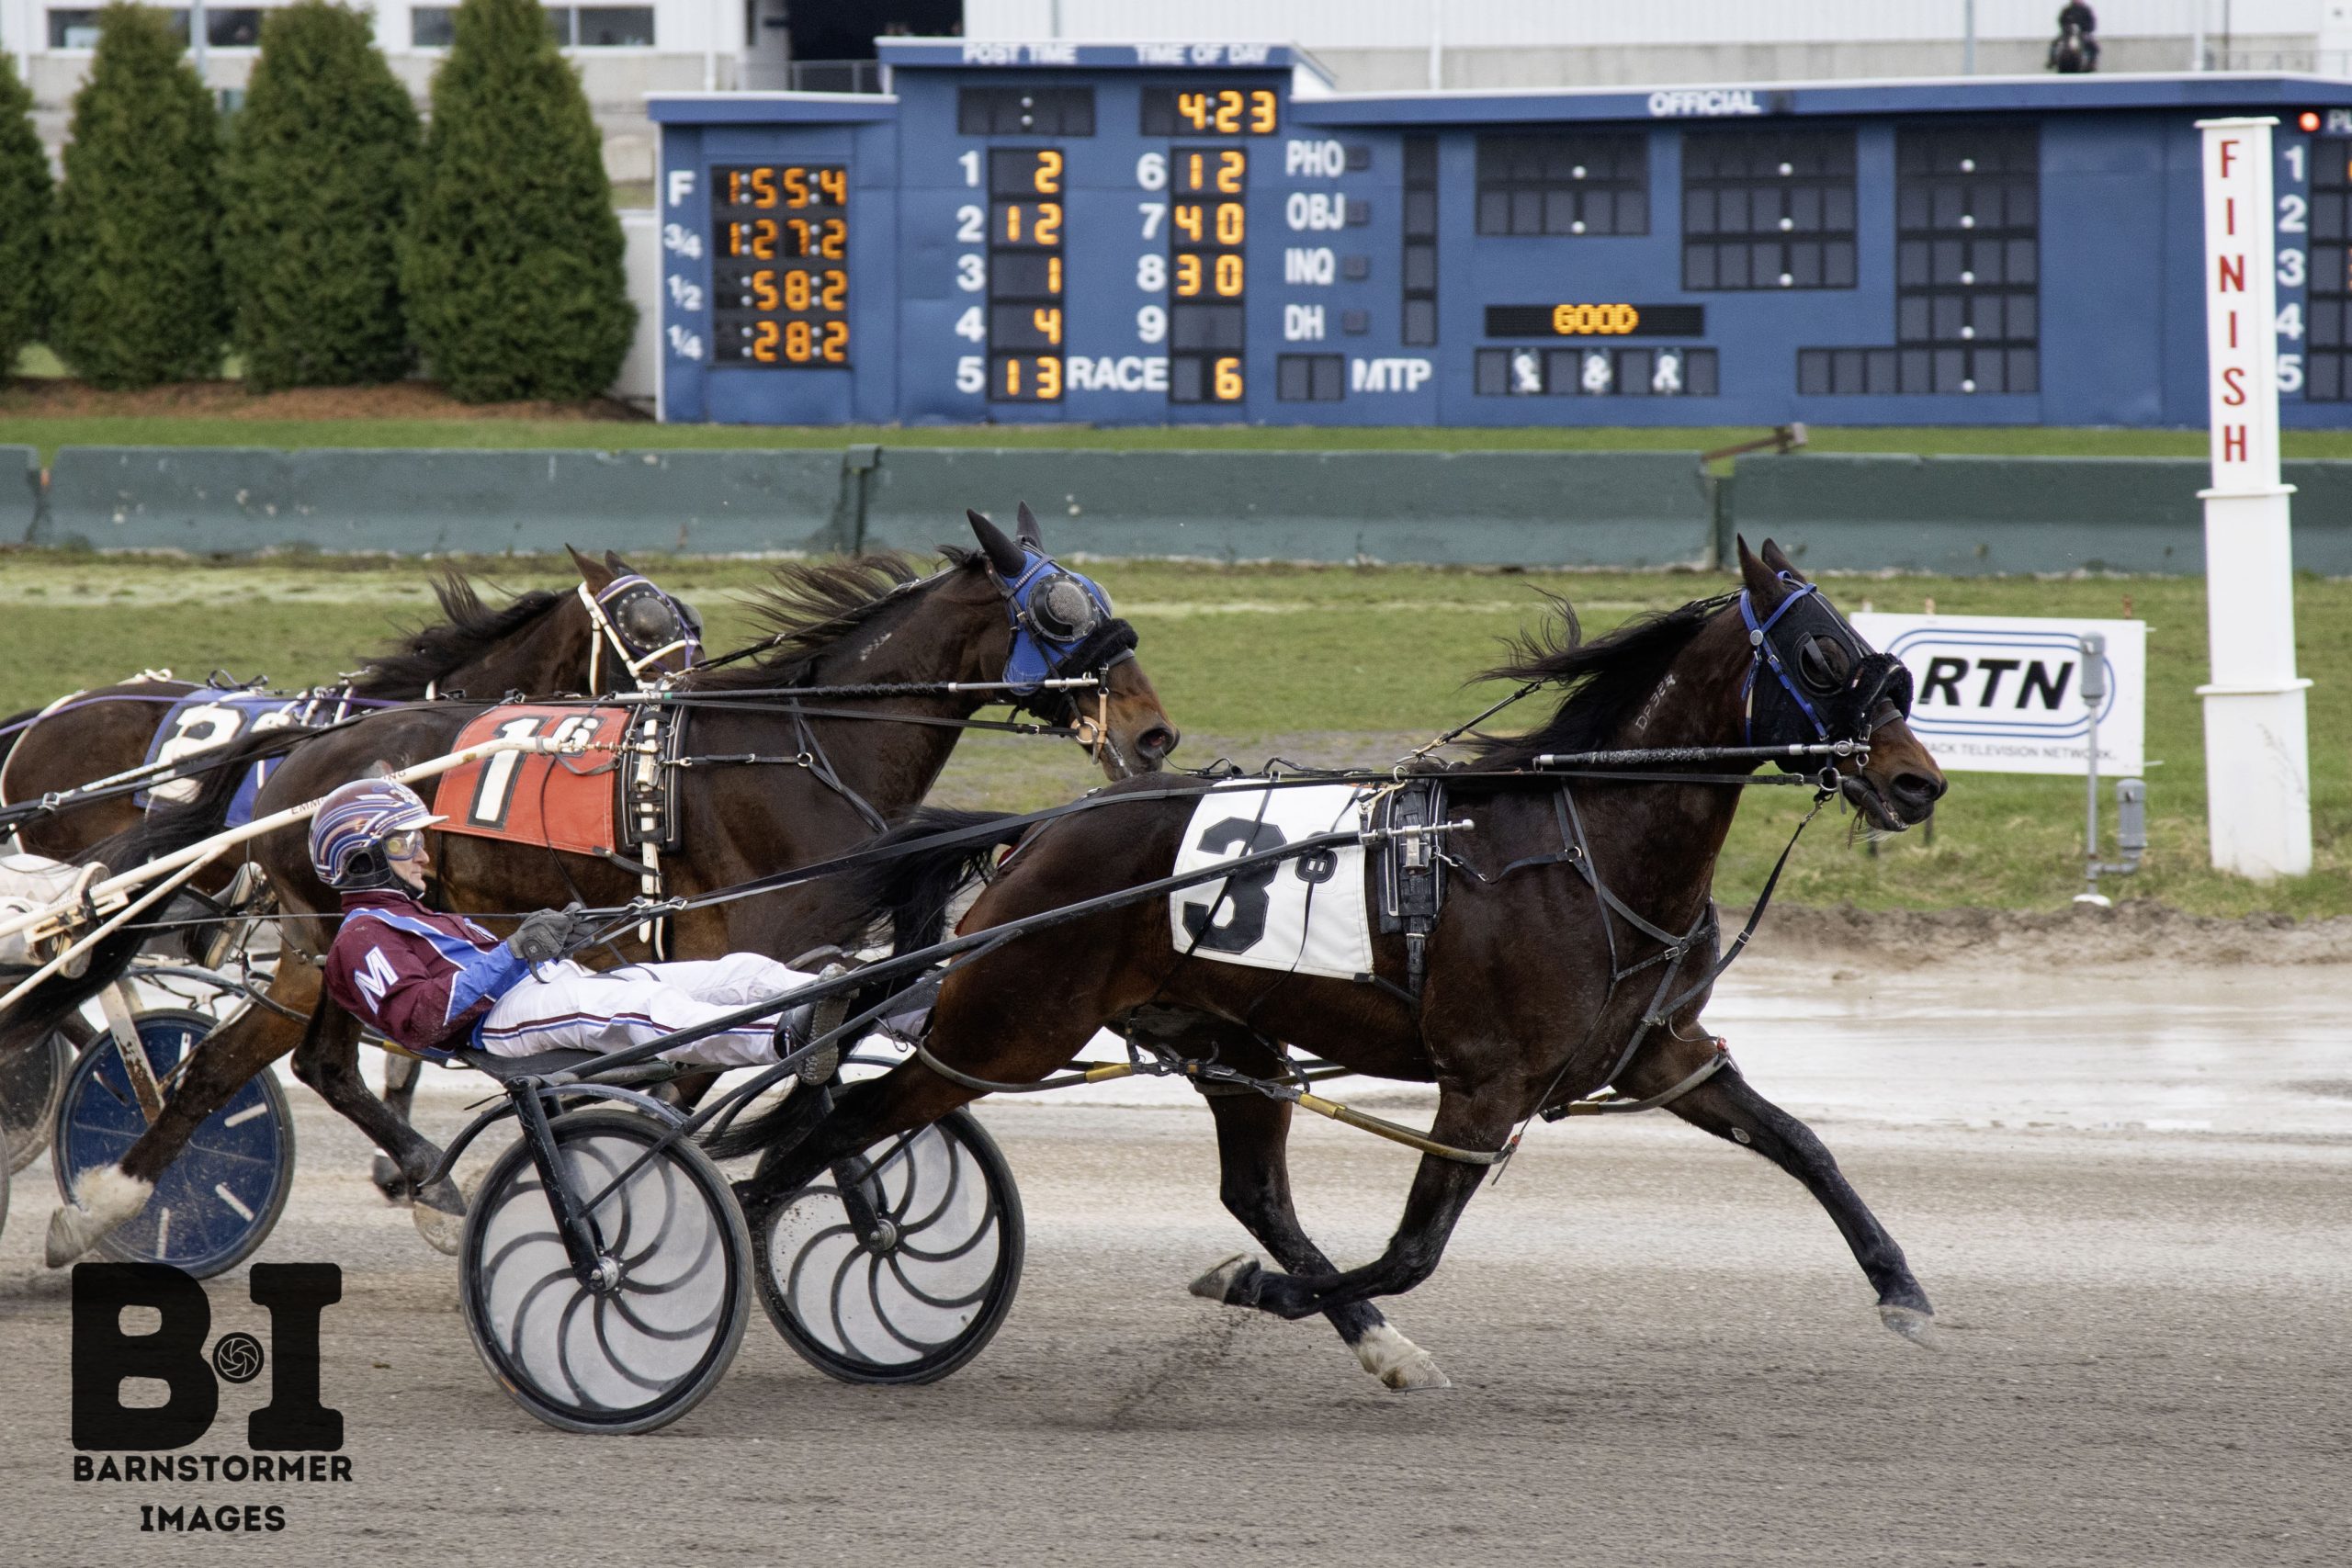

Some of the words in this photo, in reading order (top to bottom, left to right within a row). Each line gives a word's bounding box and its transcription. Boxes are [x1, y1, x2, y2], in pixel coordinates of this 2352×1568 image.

[963, 44, 1020, 64] POST
[1024, 44, 1078, 64] TIME
[1136, 44, 1184, 64] TIME
[1191, 44, 1224, 64] OF
[1227, 44, 1271, 64] DAY
[1179, 90, 1277, 133] 4:23
[1648, 89, 1761, 117] OFFICIAL
[958, 151, 979, 187] 1
[1035, 151, 1063, 194] 2
[1136, 152, 1167, 191] 6
[1190, 152, 1246, 193] 12
[1286, 140, 1345, 177] PHO
[2284, 145, 2303, 182] 1
[669, 171, 695, 207] F
[956, 205, 984, 243] 2
[1007, 203, 1063, 244] 12
[1137, 203, 1166, 240] 7
[1175, 203, 1244, 244] 40
[1287, 193, 1345, 231] OBJ
[2278, 194, 2307, 232] 2
[956, 254, 985, 291] 3
[1048, 256, 1062, 293] 1
[1136, 254, 1167, 292] 8
[1177, 254, 1244, 297] 30
[1285, 248, 1335, 285] INQ
[2277, 248, 2305, 287] 3
[1553, 304, 1639, 334] GOOD
[2219, 140, 2246, 462] FINISH
[955, 306, 985, 343] 4
[1034, 309, 1062, 344] 4
[1136, 305, 1168, 344] 9
[1284, 304, 1324, 340] DH
[2276, 303, 2304, 340] 4
[956, 356, 985, 393] 5
[1007, 356, 1062, 399] 13
[1067, 356, 1170, 391] RACE
[1215, 357, 1244, 400] 6
[1351, 358, 1431, 391] MTP
[2277, 354, 2303, 392] 5
[1918, 657, 2074, 710] RTN
[470, 716, 546, 827] 1
[1182, 817, 1287, 954] 3
[353, 945, 400, 1015] M
